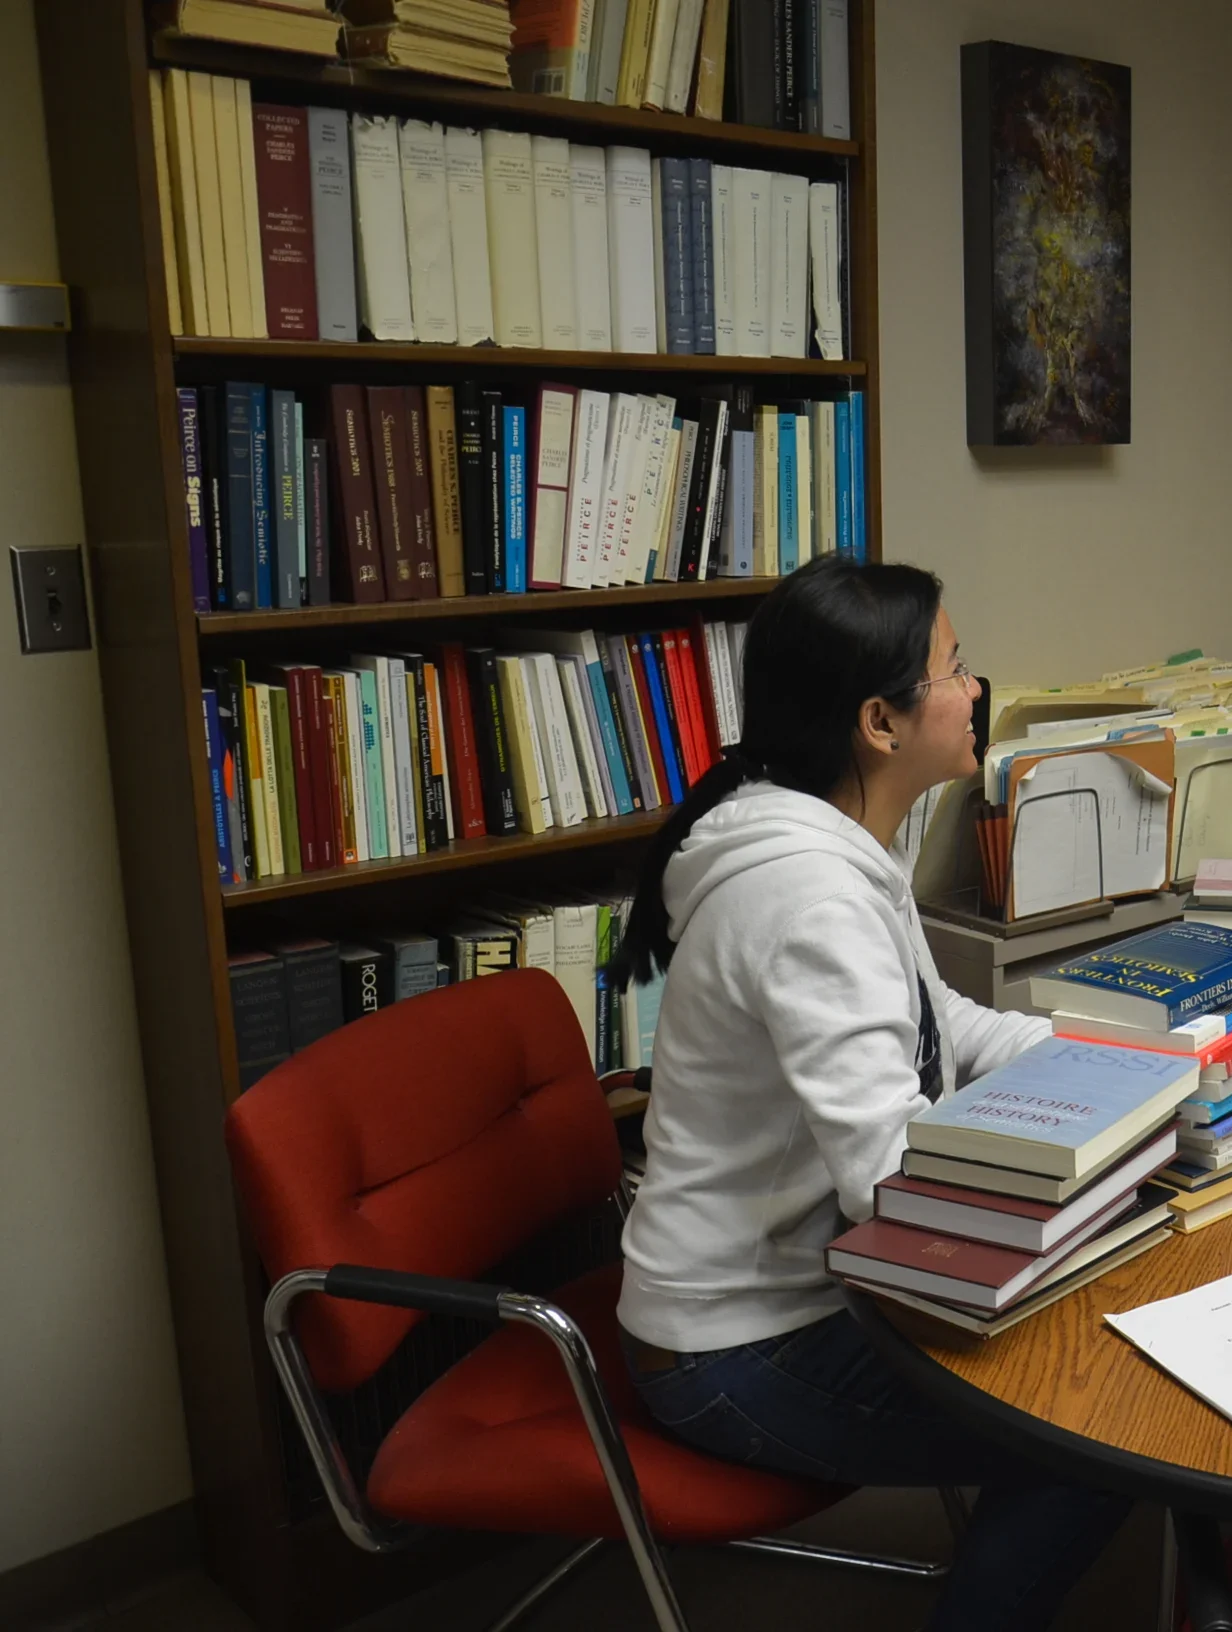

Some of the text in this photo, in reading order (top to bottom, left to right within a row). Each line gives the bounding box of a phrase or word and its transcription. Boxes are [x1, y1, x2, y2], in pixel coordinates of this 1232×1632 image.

[785, 21, 793, 64] SANDERS
[785, 65, 793, 99] PEIRCE
[257, 114, 300, 125] COLLECTED
[266, 123, 294, 133] PAPERS
[182, 407, 196, 453] Peirce
[346, 409, 360, 477] SEMIOTICS 2001
[411, 409, 421, 456] SEMIOTICS
[186, 454, 197, 472] on
[447, 429, 456, 480] CHARLES
[186, 476, 201, 528] Signs
[254, 431, 268, 565] Introducing Semiotic
[282, 475, 294, 521] PEIRCE
[676, 450, 691, 532] PHILOSOPHICAL WRITINGS
[451, 494, 460, 535] PEIRCE
[580, 498, 593, 562] PEIRCE
[602, 498, 618, 562] PEIRCE
[620, 494, 636, 556] PEIRCE
[422, 732, 430, 757] Classical
[490, 684, 505, 772] DYNAMIQUES DE L'ERREUR
[268, 785, 274, 793] LA
[424, 759, 432, 786] American
[426, 787, 434, 820] Philosophy
[1057, 967, 1174, 998] FRONTIERS
[1089, 954, 1203, 983] SEMIOTICS
[1120, 967, 1145, 978] IN
[362, 963, 378, 1012] ROGET
[1179, 982, 1227, 1013] FRONTIERS
[599, 990, 607, 1025] Knowledge
[1201, 1000, 1215, 1012] Deely,
[598, 1032, 606, 1063] Formation
[1051, 1044, 1182, 1078] RSSI
[966, 1104, 1071, 1128] HISTORY
[983, 1090, 1098, 1117] HISTOIRE
